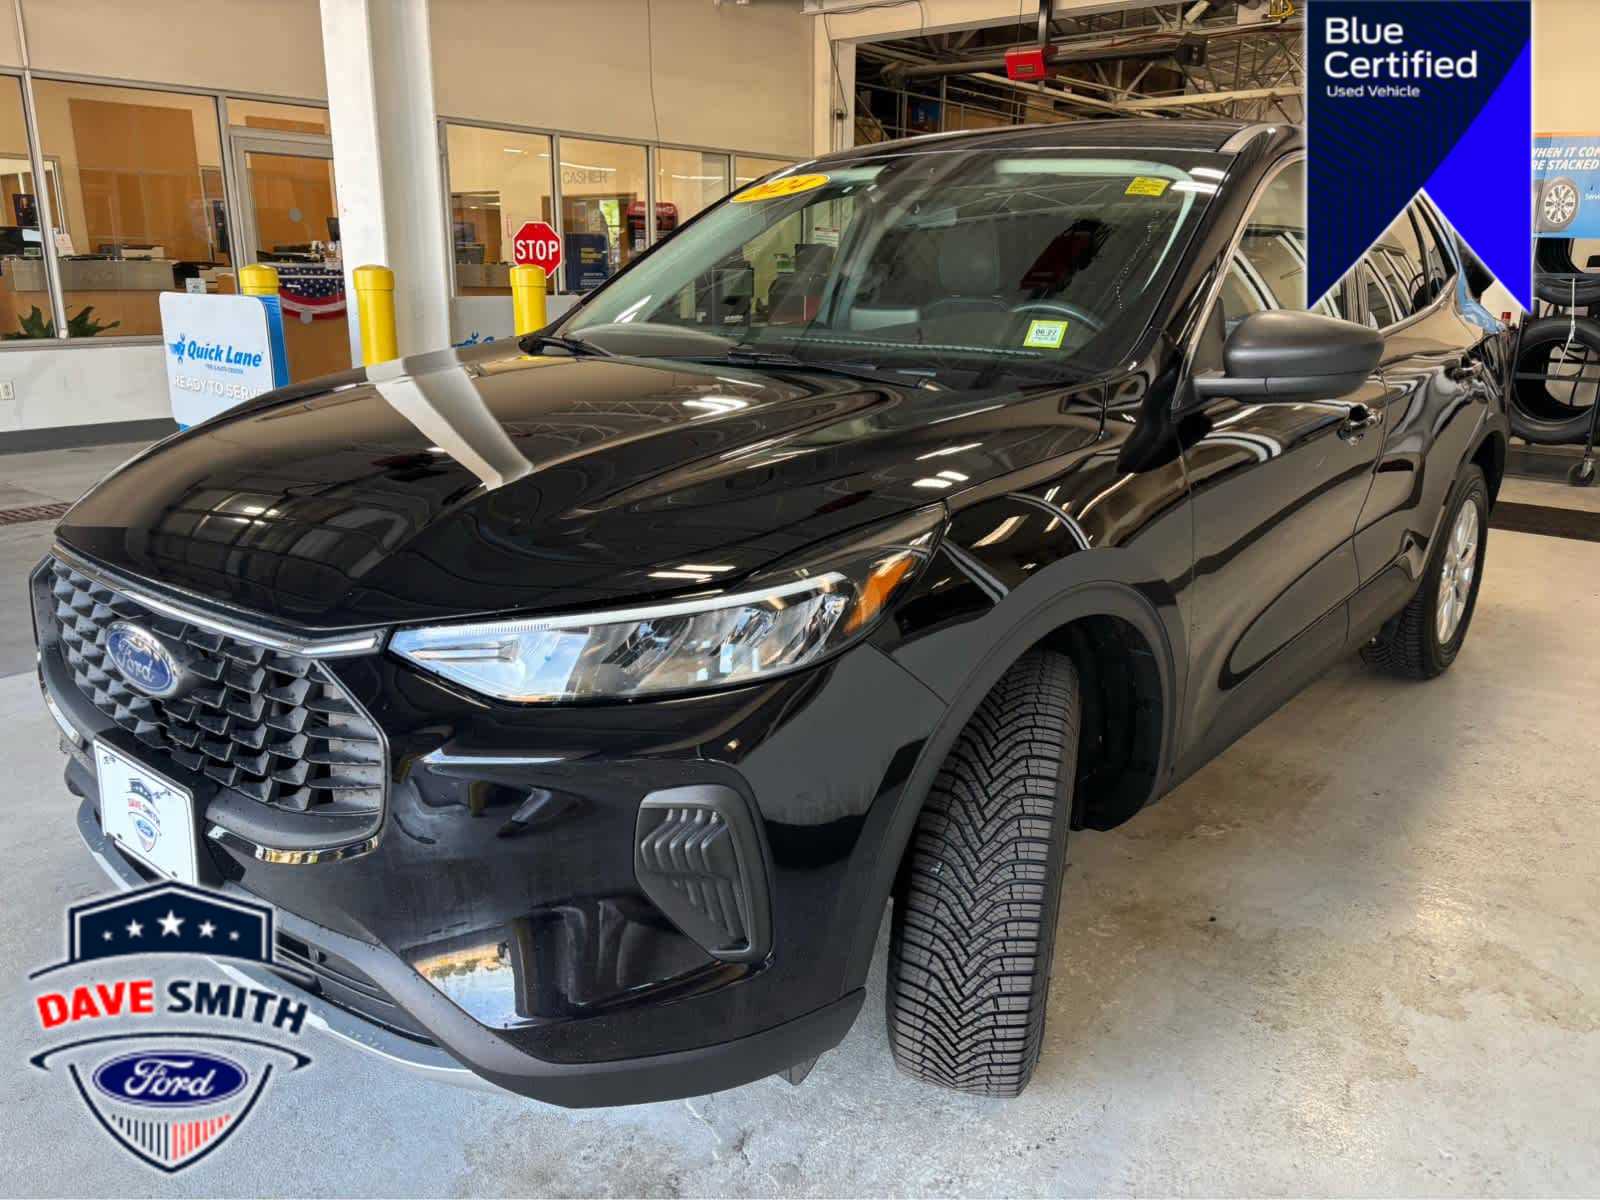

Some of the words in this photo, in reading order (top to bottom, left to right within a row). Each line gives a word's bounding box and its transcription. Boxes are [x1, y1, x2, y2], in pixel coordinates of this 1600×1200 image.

[1563, 146, 1577, 158] IT
[1547, 158, 1600, 170] STACKED
[562, 170, 608, 185] CASHIER
[516, 239, 559, 261] STOP
[187, 340, 224, 362] Quick
[225, 345, 263, 367] Lane
[116, 638, 154, 682] Ford
